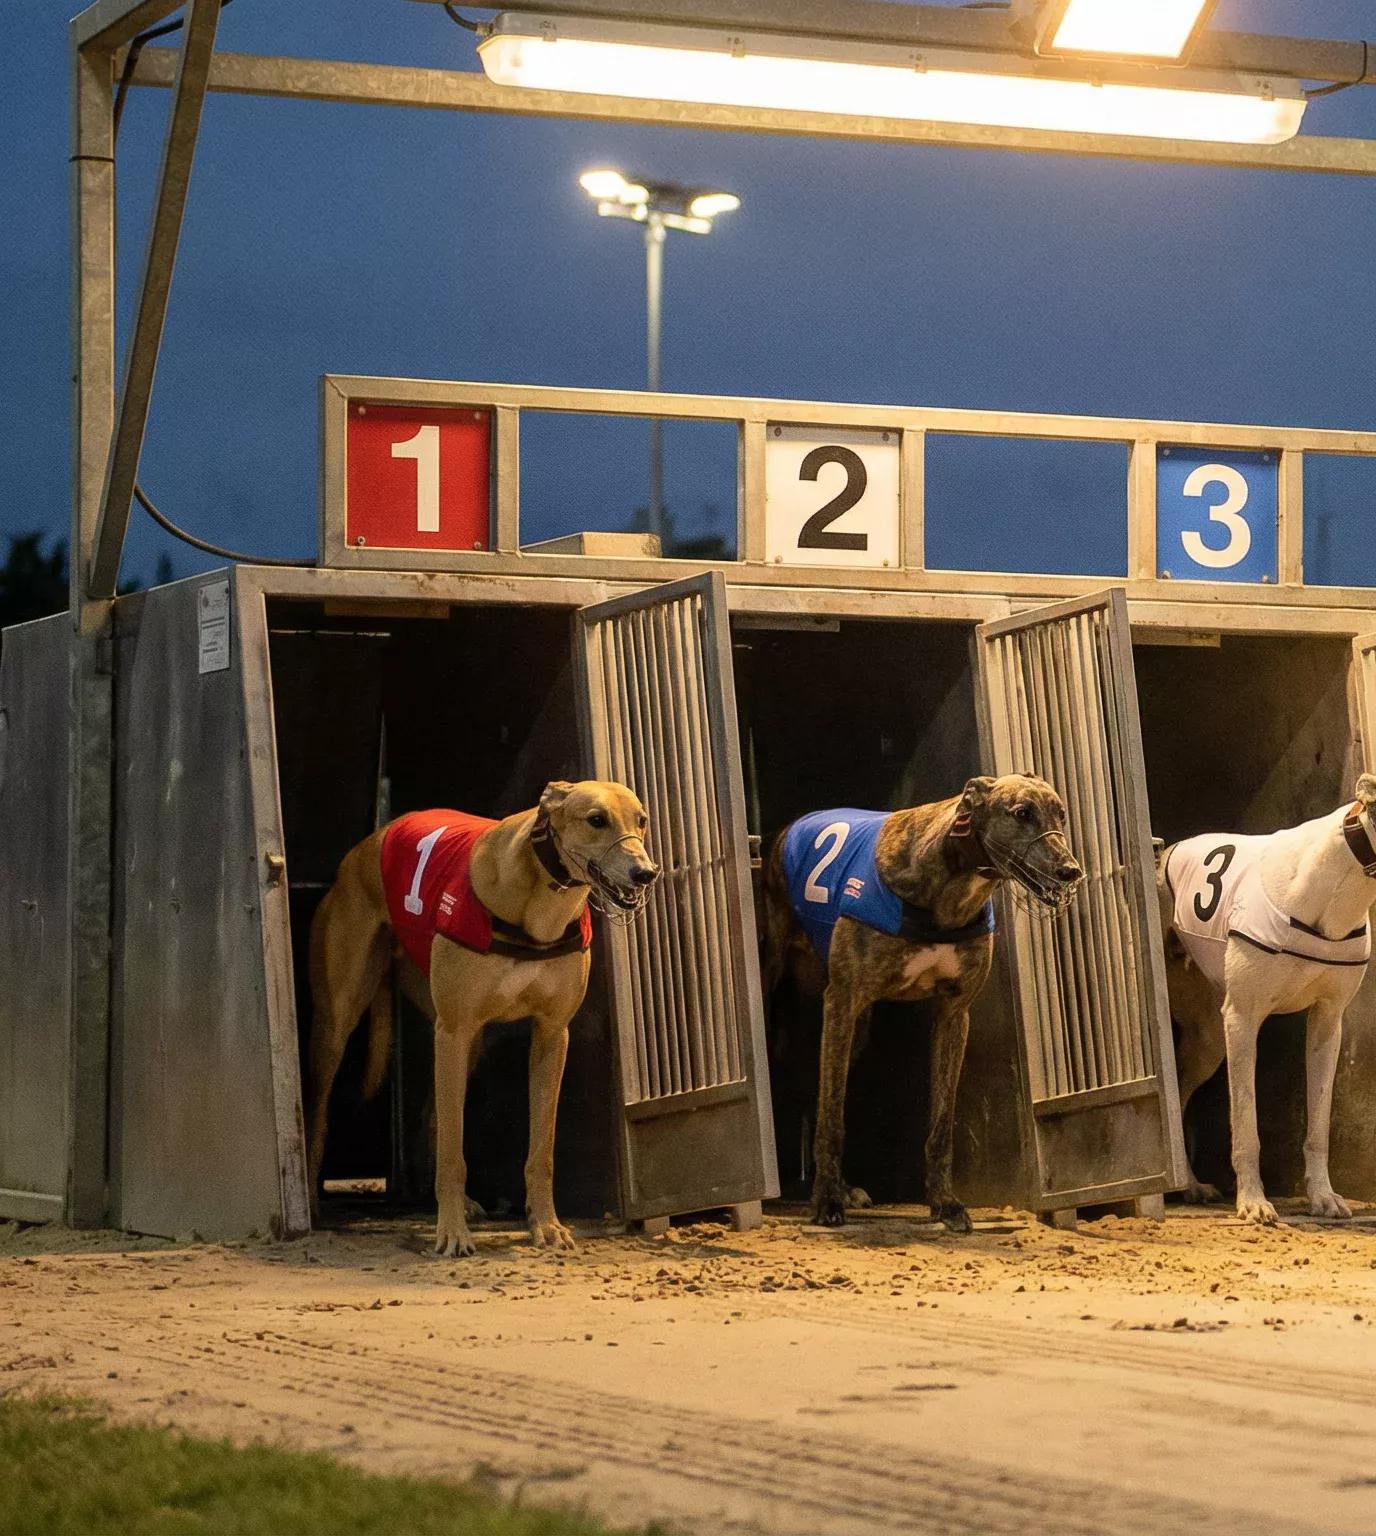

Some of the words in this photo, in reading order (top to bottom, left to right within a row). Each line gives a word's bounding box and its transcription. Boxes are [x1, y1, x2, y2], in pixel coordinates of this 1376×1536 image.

[391, 425, 440, 532] 1
[797, 445, 868, 551] 2
[1180, 463, 1252, 568] 3
[404, 825, 448, 915] 1
[804, 821, 850, 904] 2
[1193, 844, 1236, 923] 3
